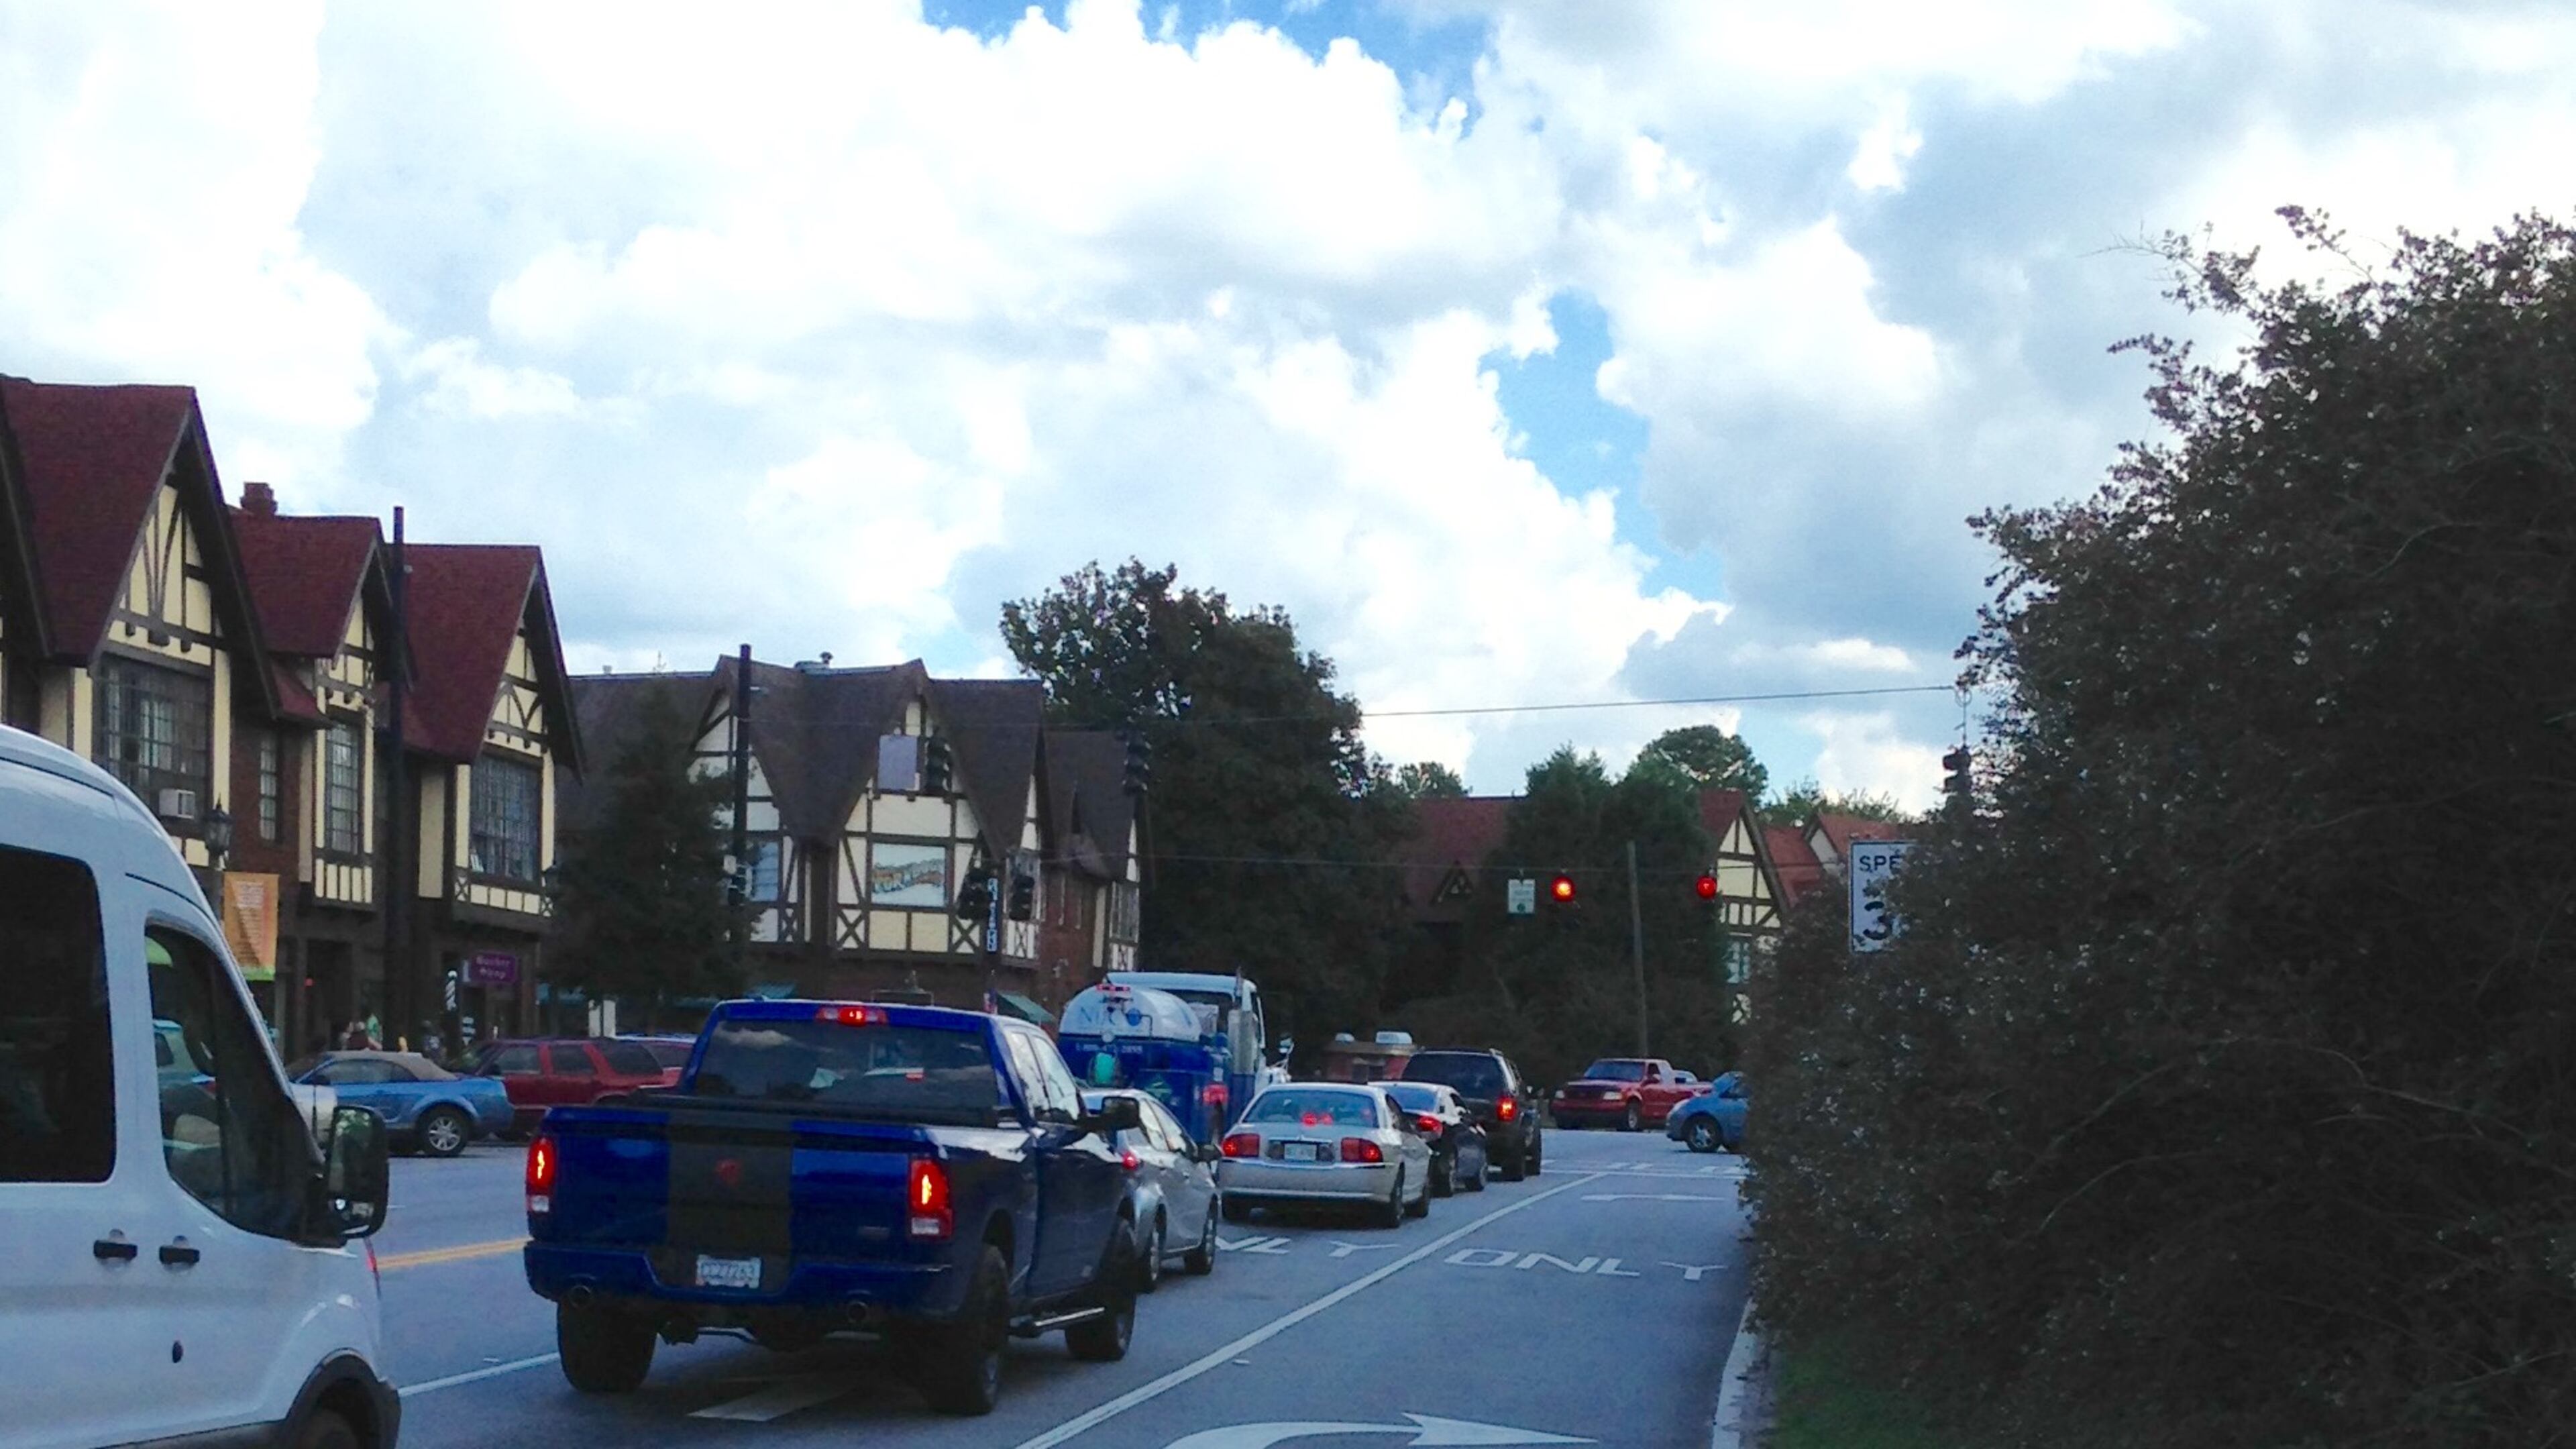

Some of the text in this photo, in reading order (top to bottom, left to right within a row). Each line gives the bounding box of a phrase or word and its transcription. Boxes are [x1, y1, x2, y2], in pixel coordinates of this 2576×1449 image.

[1859, 855, 1900, 871] SPE
[1863, 901, 1892, 941] 3
[1215, 1236, 1401, 1258] NLY
[1444, 1248, 1728, 1281] ONLY
